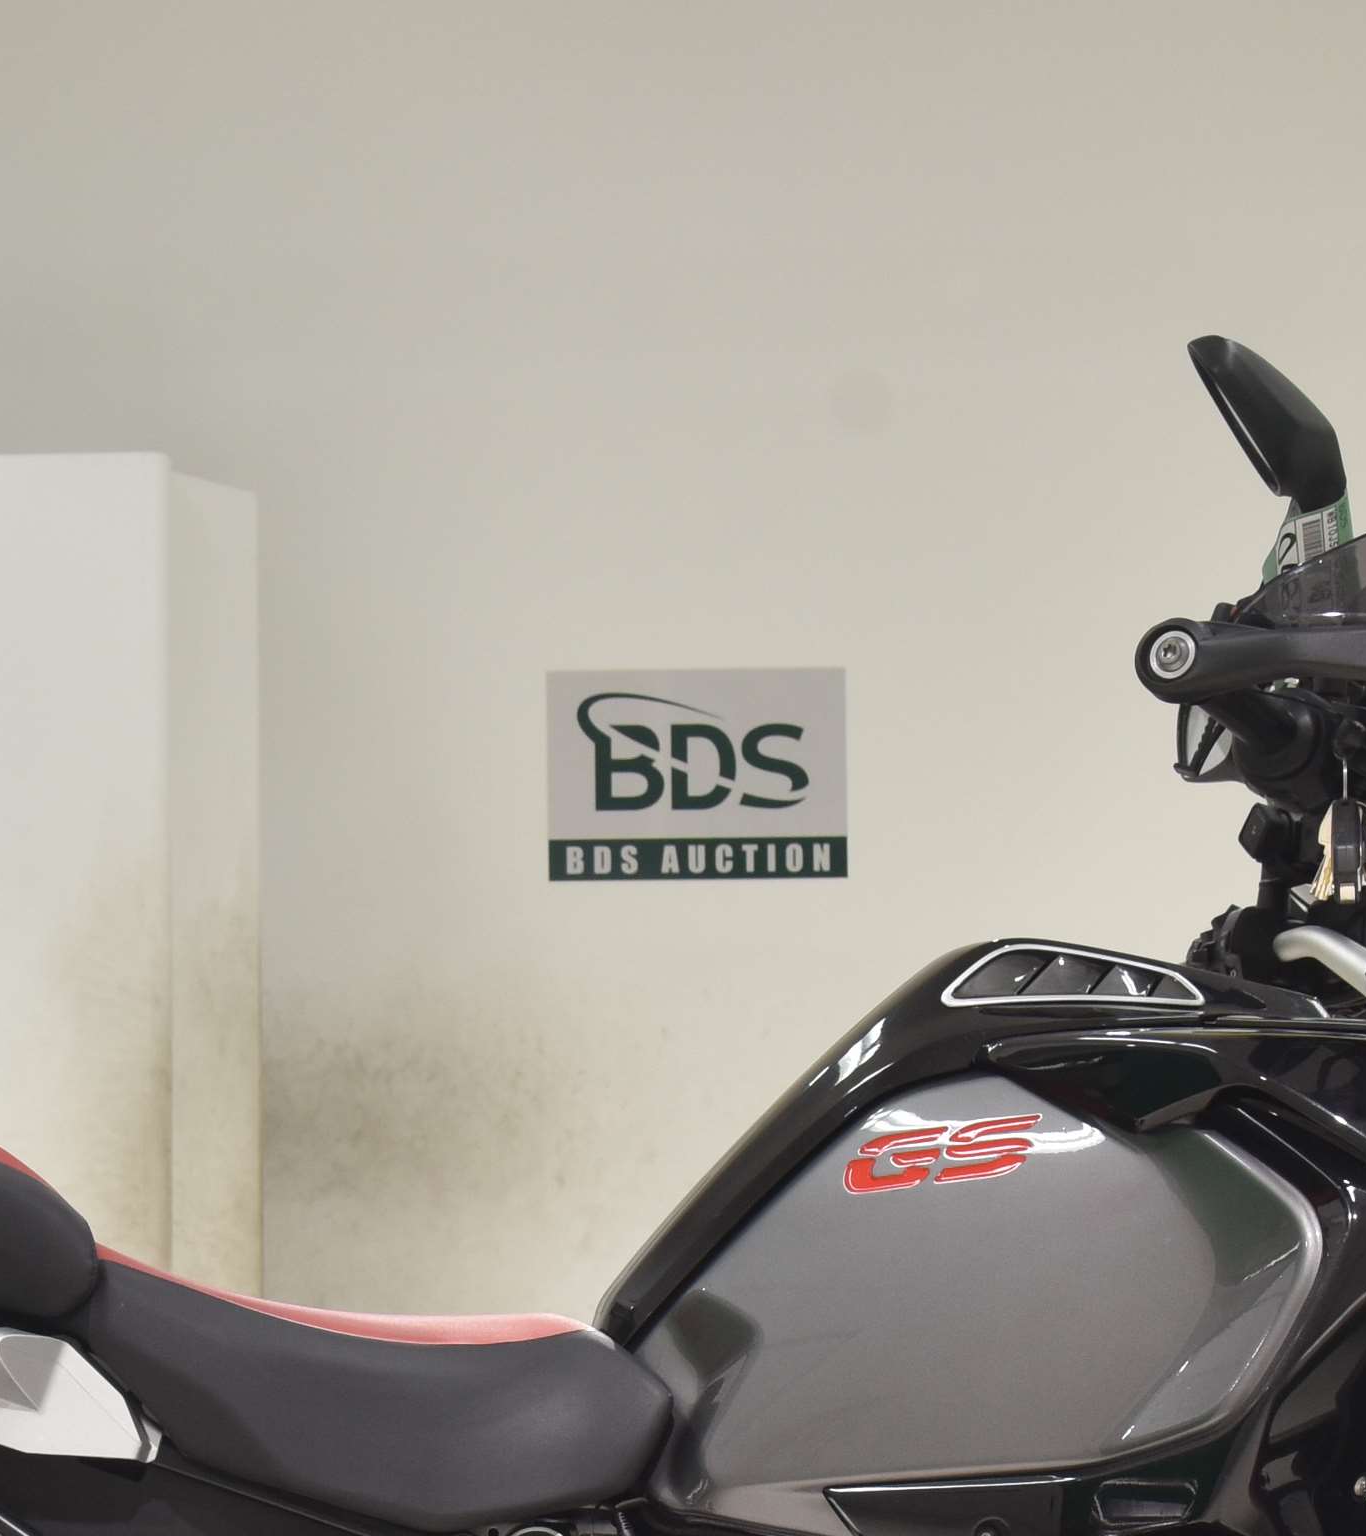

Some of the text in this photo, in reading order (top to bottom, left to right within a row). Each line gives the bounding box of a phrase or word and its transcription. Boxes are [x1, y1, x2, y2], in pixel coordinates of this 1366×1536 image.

[577, 693, 809, 811] BDS
[565, 843, 831, 875] BDS AUCTION
[843, 1114, 1042, 1194] GS
